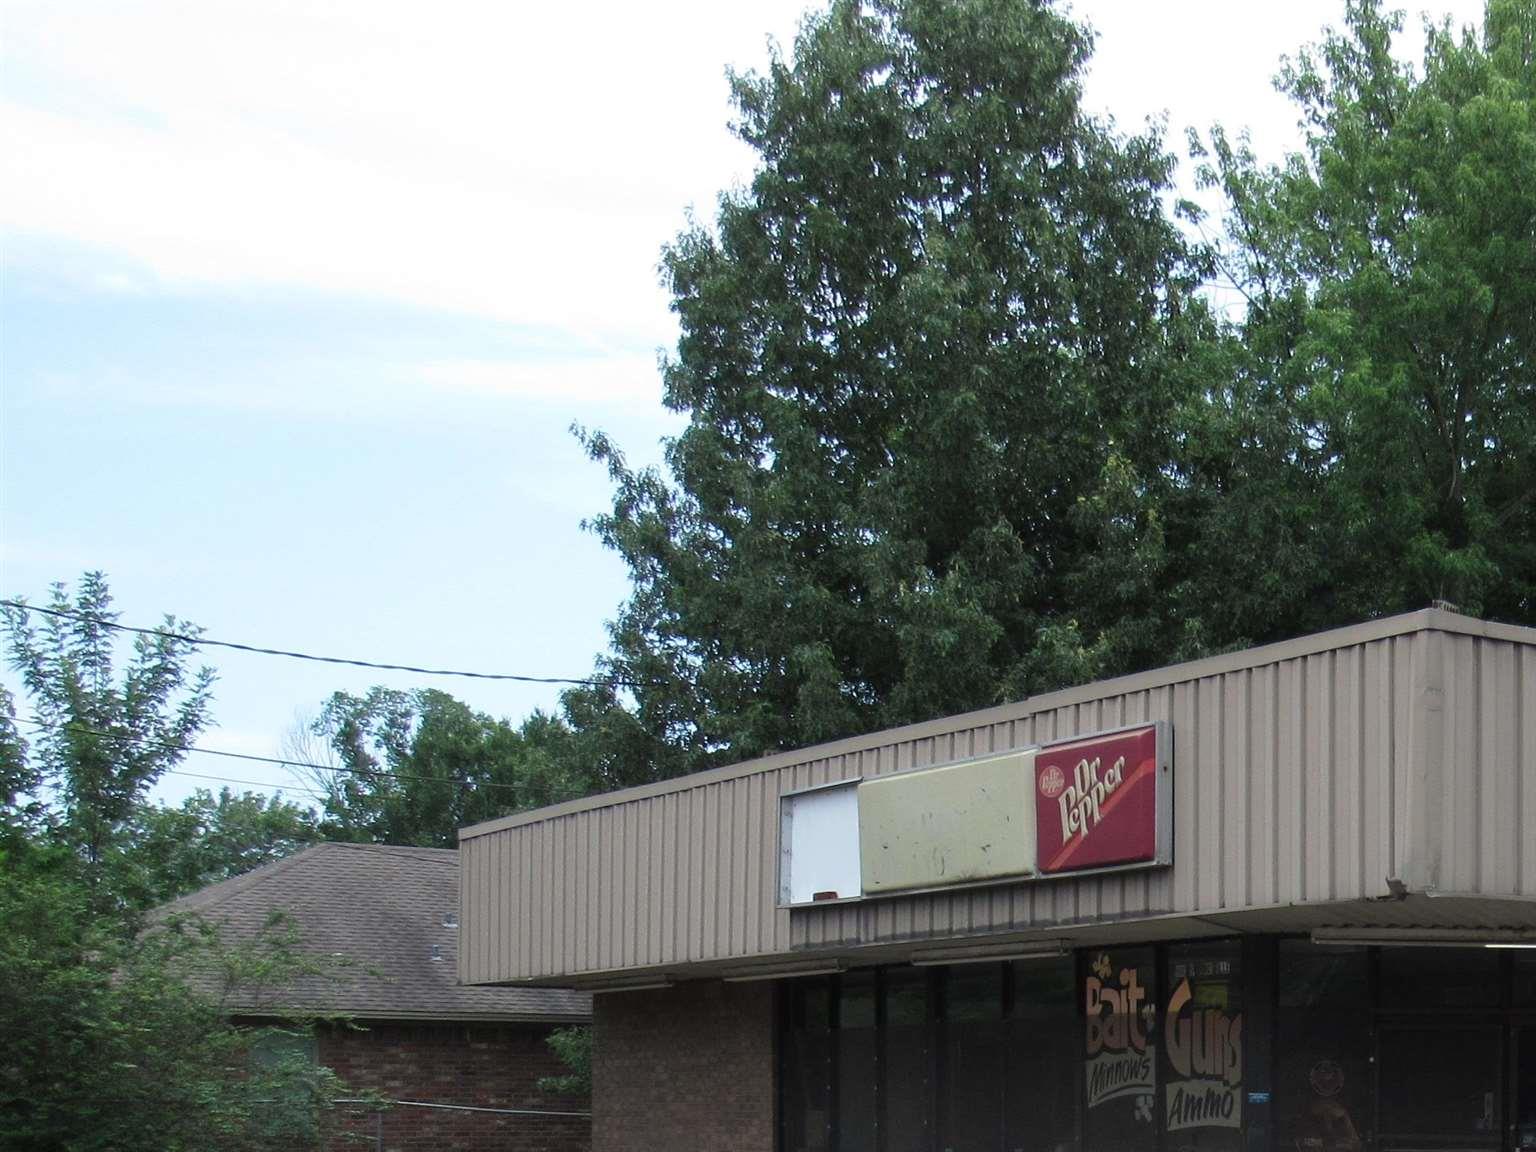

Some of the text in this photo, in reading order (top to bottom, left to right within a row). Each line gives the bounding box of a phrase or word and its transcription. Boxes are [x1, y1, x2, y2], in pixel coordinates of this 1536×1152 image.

[1058, 756, 1126, 846] Pepper
[1073, 757, 1102, 803] Dr
[1085, 967, 1147, 1056] Bait
[1165, 974, 1243, 1086] Guns
[1088, 1058, 1151, 1104] Minnows
[1167, 1088, 1235, 1126] Ammo
